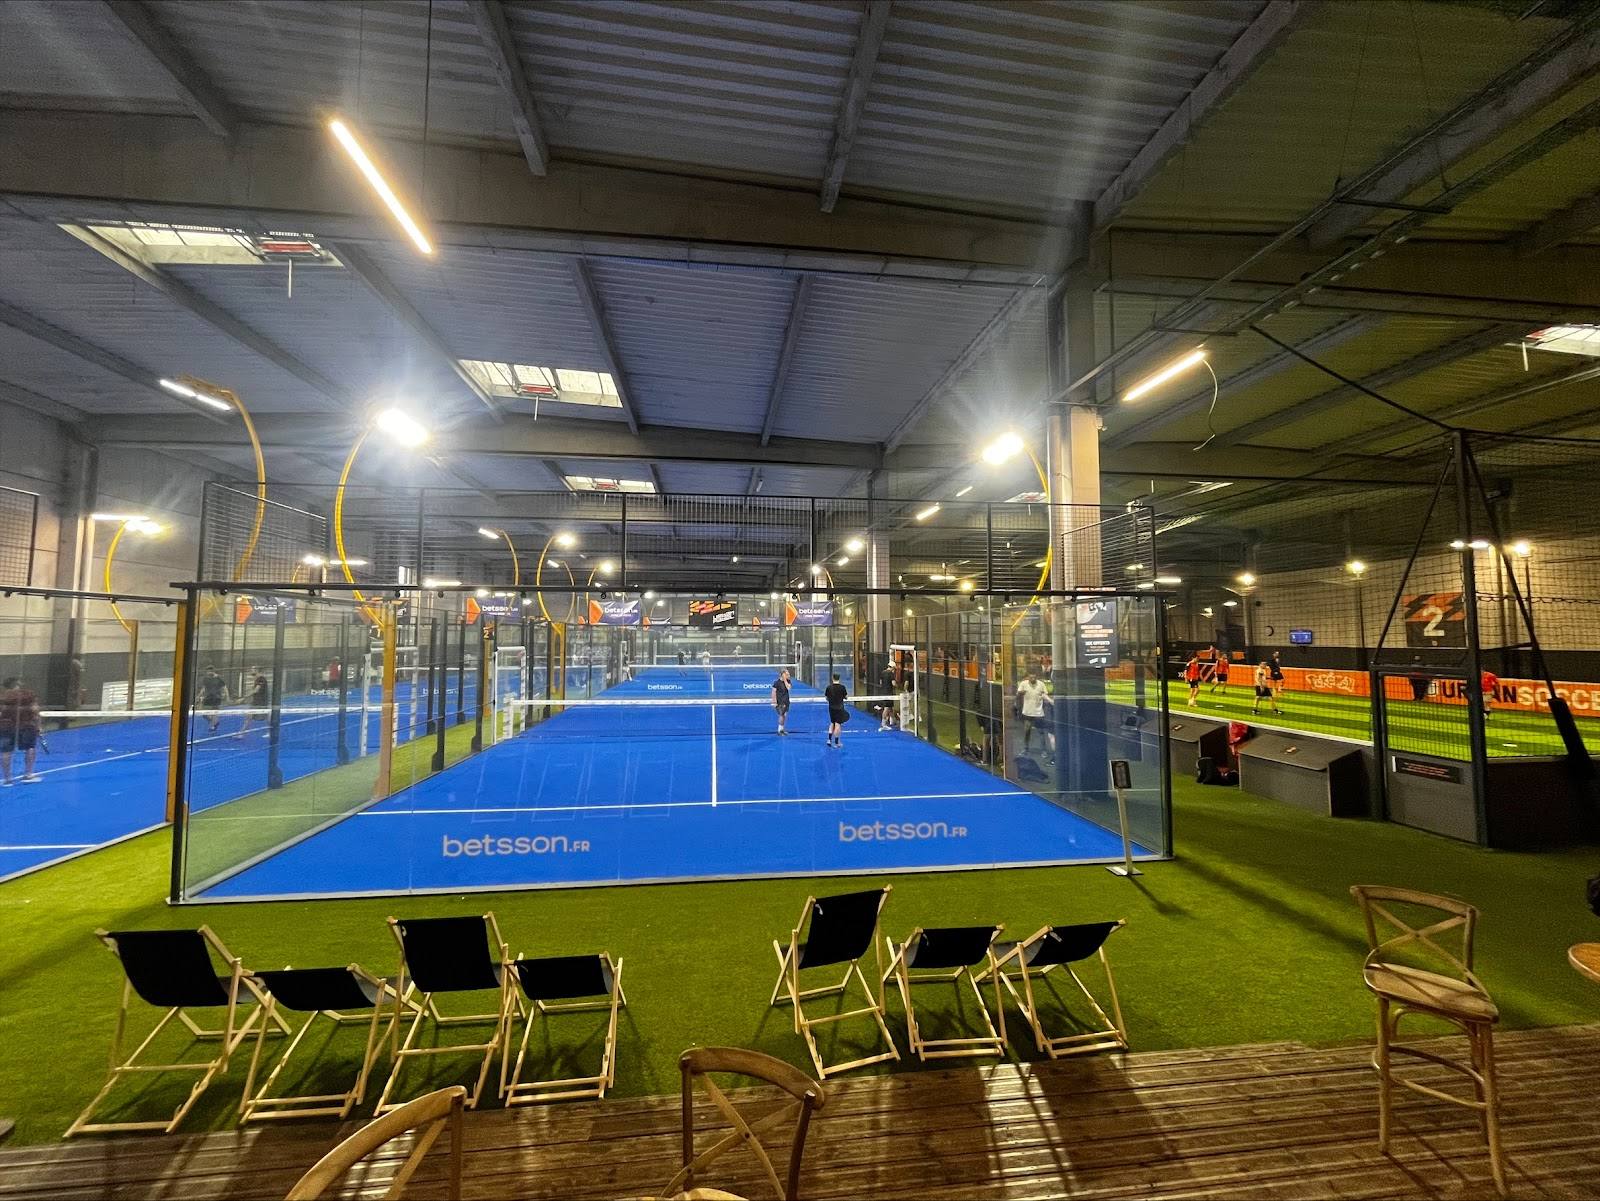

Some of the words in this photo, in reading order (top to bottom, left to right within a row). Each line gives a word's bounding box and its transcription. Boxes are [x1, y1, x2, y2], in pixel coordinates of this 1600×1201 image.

[1422, 605, 1445, 637] 2
[839, 821, 968, 842] betsson.FR
[442, 834, 590, 857] betsson.FR
